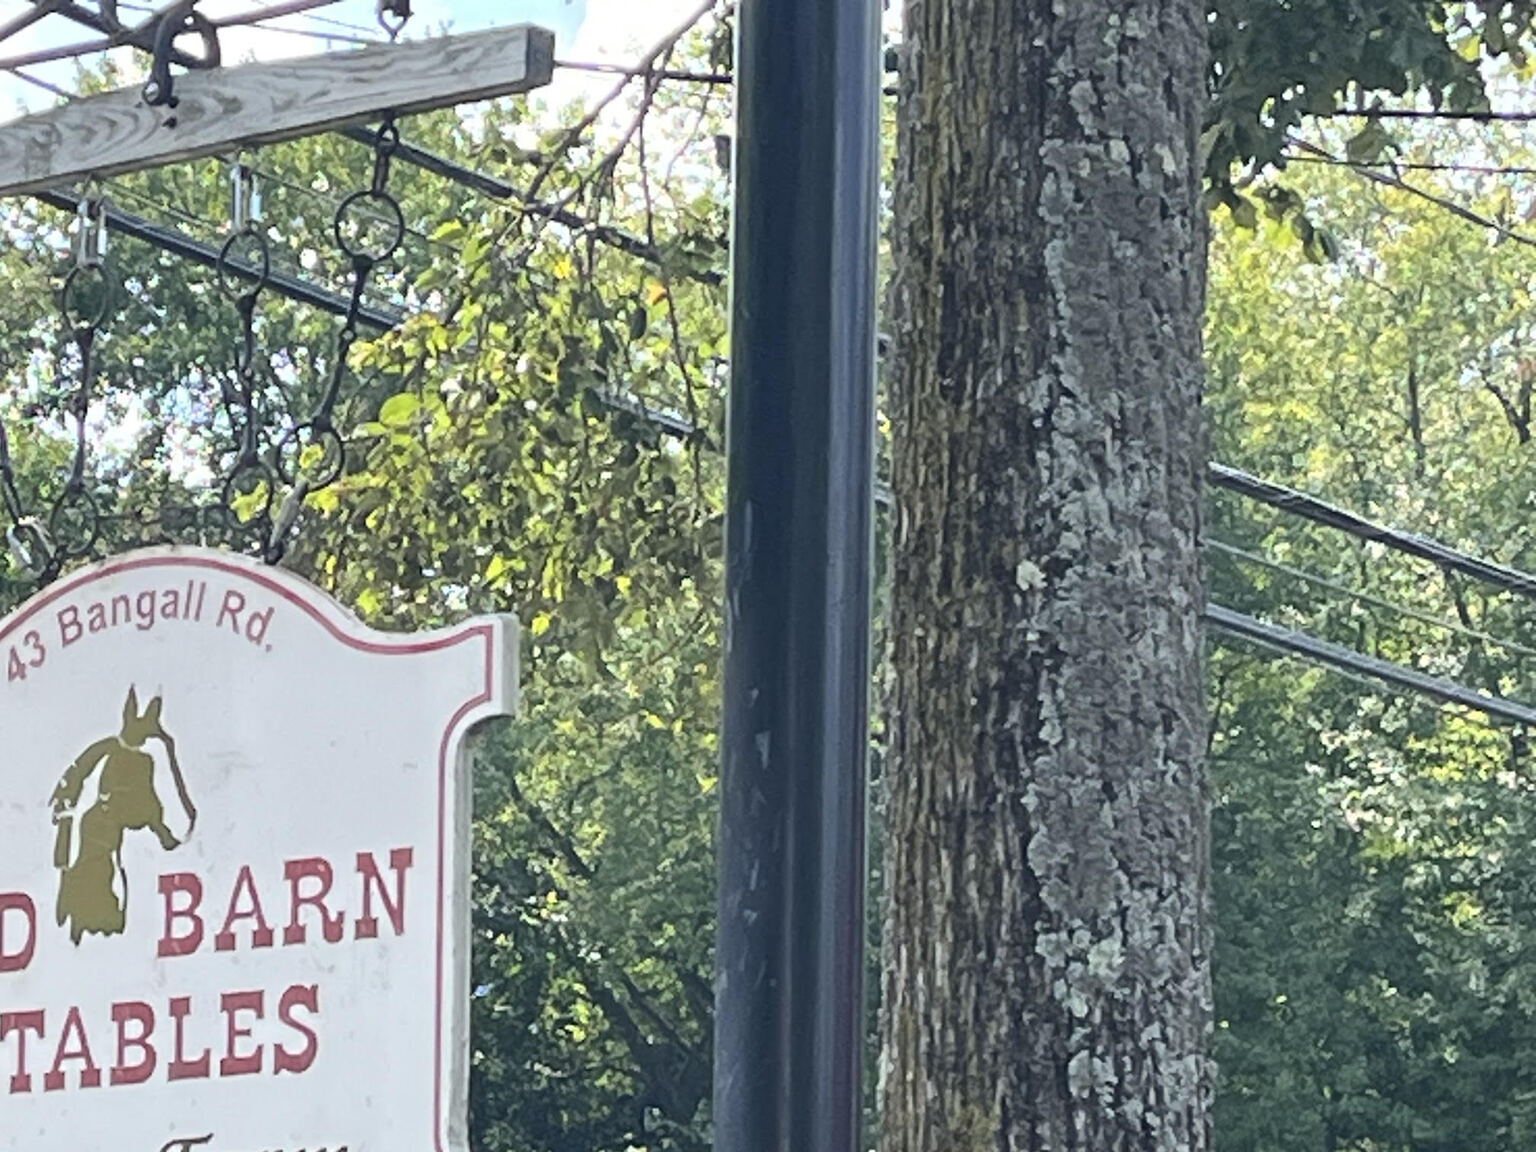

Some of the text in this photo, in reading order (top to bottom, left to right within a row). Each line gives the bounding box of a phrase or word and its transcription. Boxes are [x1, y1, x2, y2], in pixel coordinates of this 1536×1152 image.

[7, 579, 275, 682] 43 Bangall Rd.
[156, 846, 415, 959] BARN
